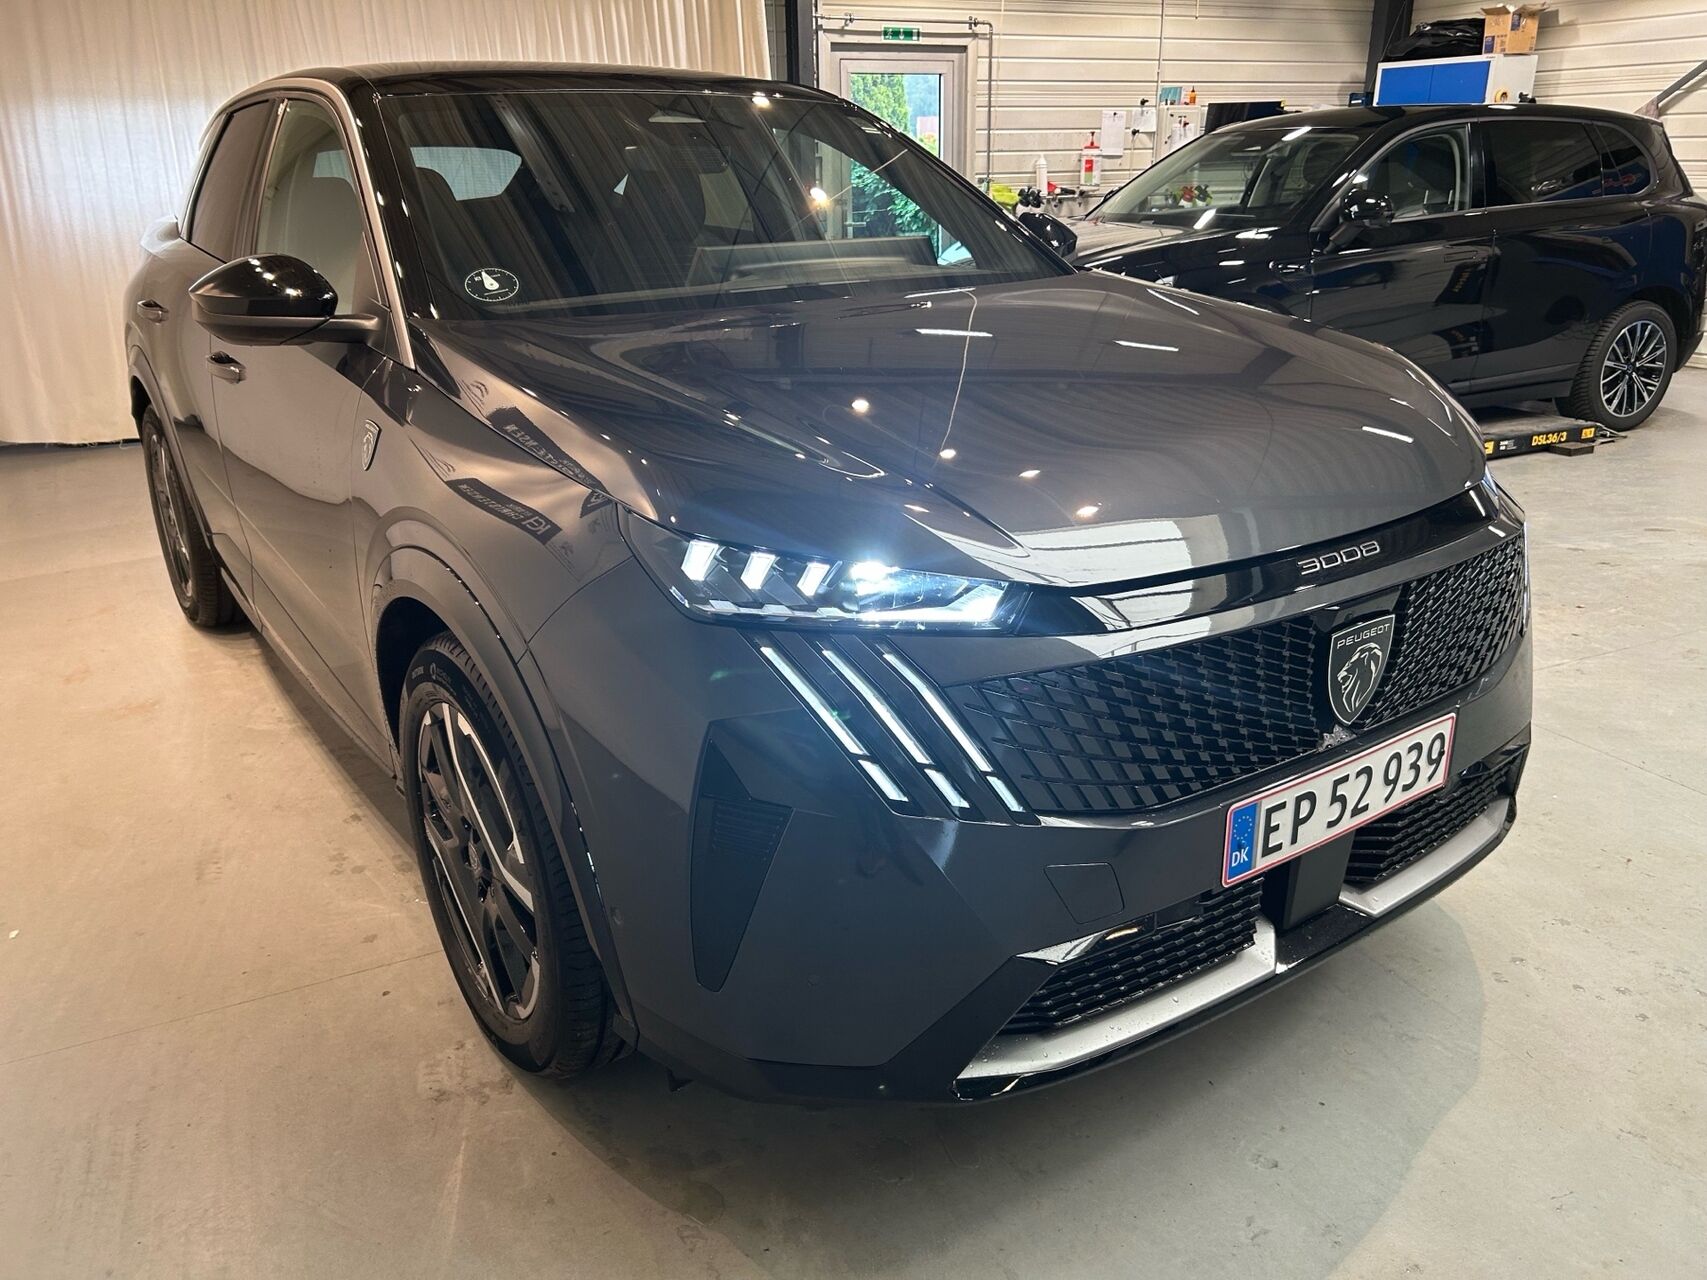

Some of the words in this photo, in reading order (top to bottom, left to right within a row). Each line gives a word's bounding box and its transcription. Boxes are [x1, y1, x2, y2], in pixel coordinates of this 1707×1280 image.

[1531, 431, 1568, 446] DSL36/3
[1298, 541, 1381, 575] 3008
[1336, 623, 1390, 649] PEUGEOT
[1261, 790, 1317, 859] EP
[1326, 765, 1373, 829] 52
[1383, 732, 1447, 803] 939
[1231, 846, 1249, 867] DK
